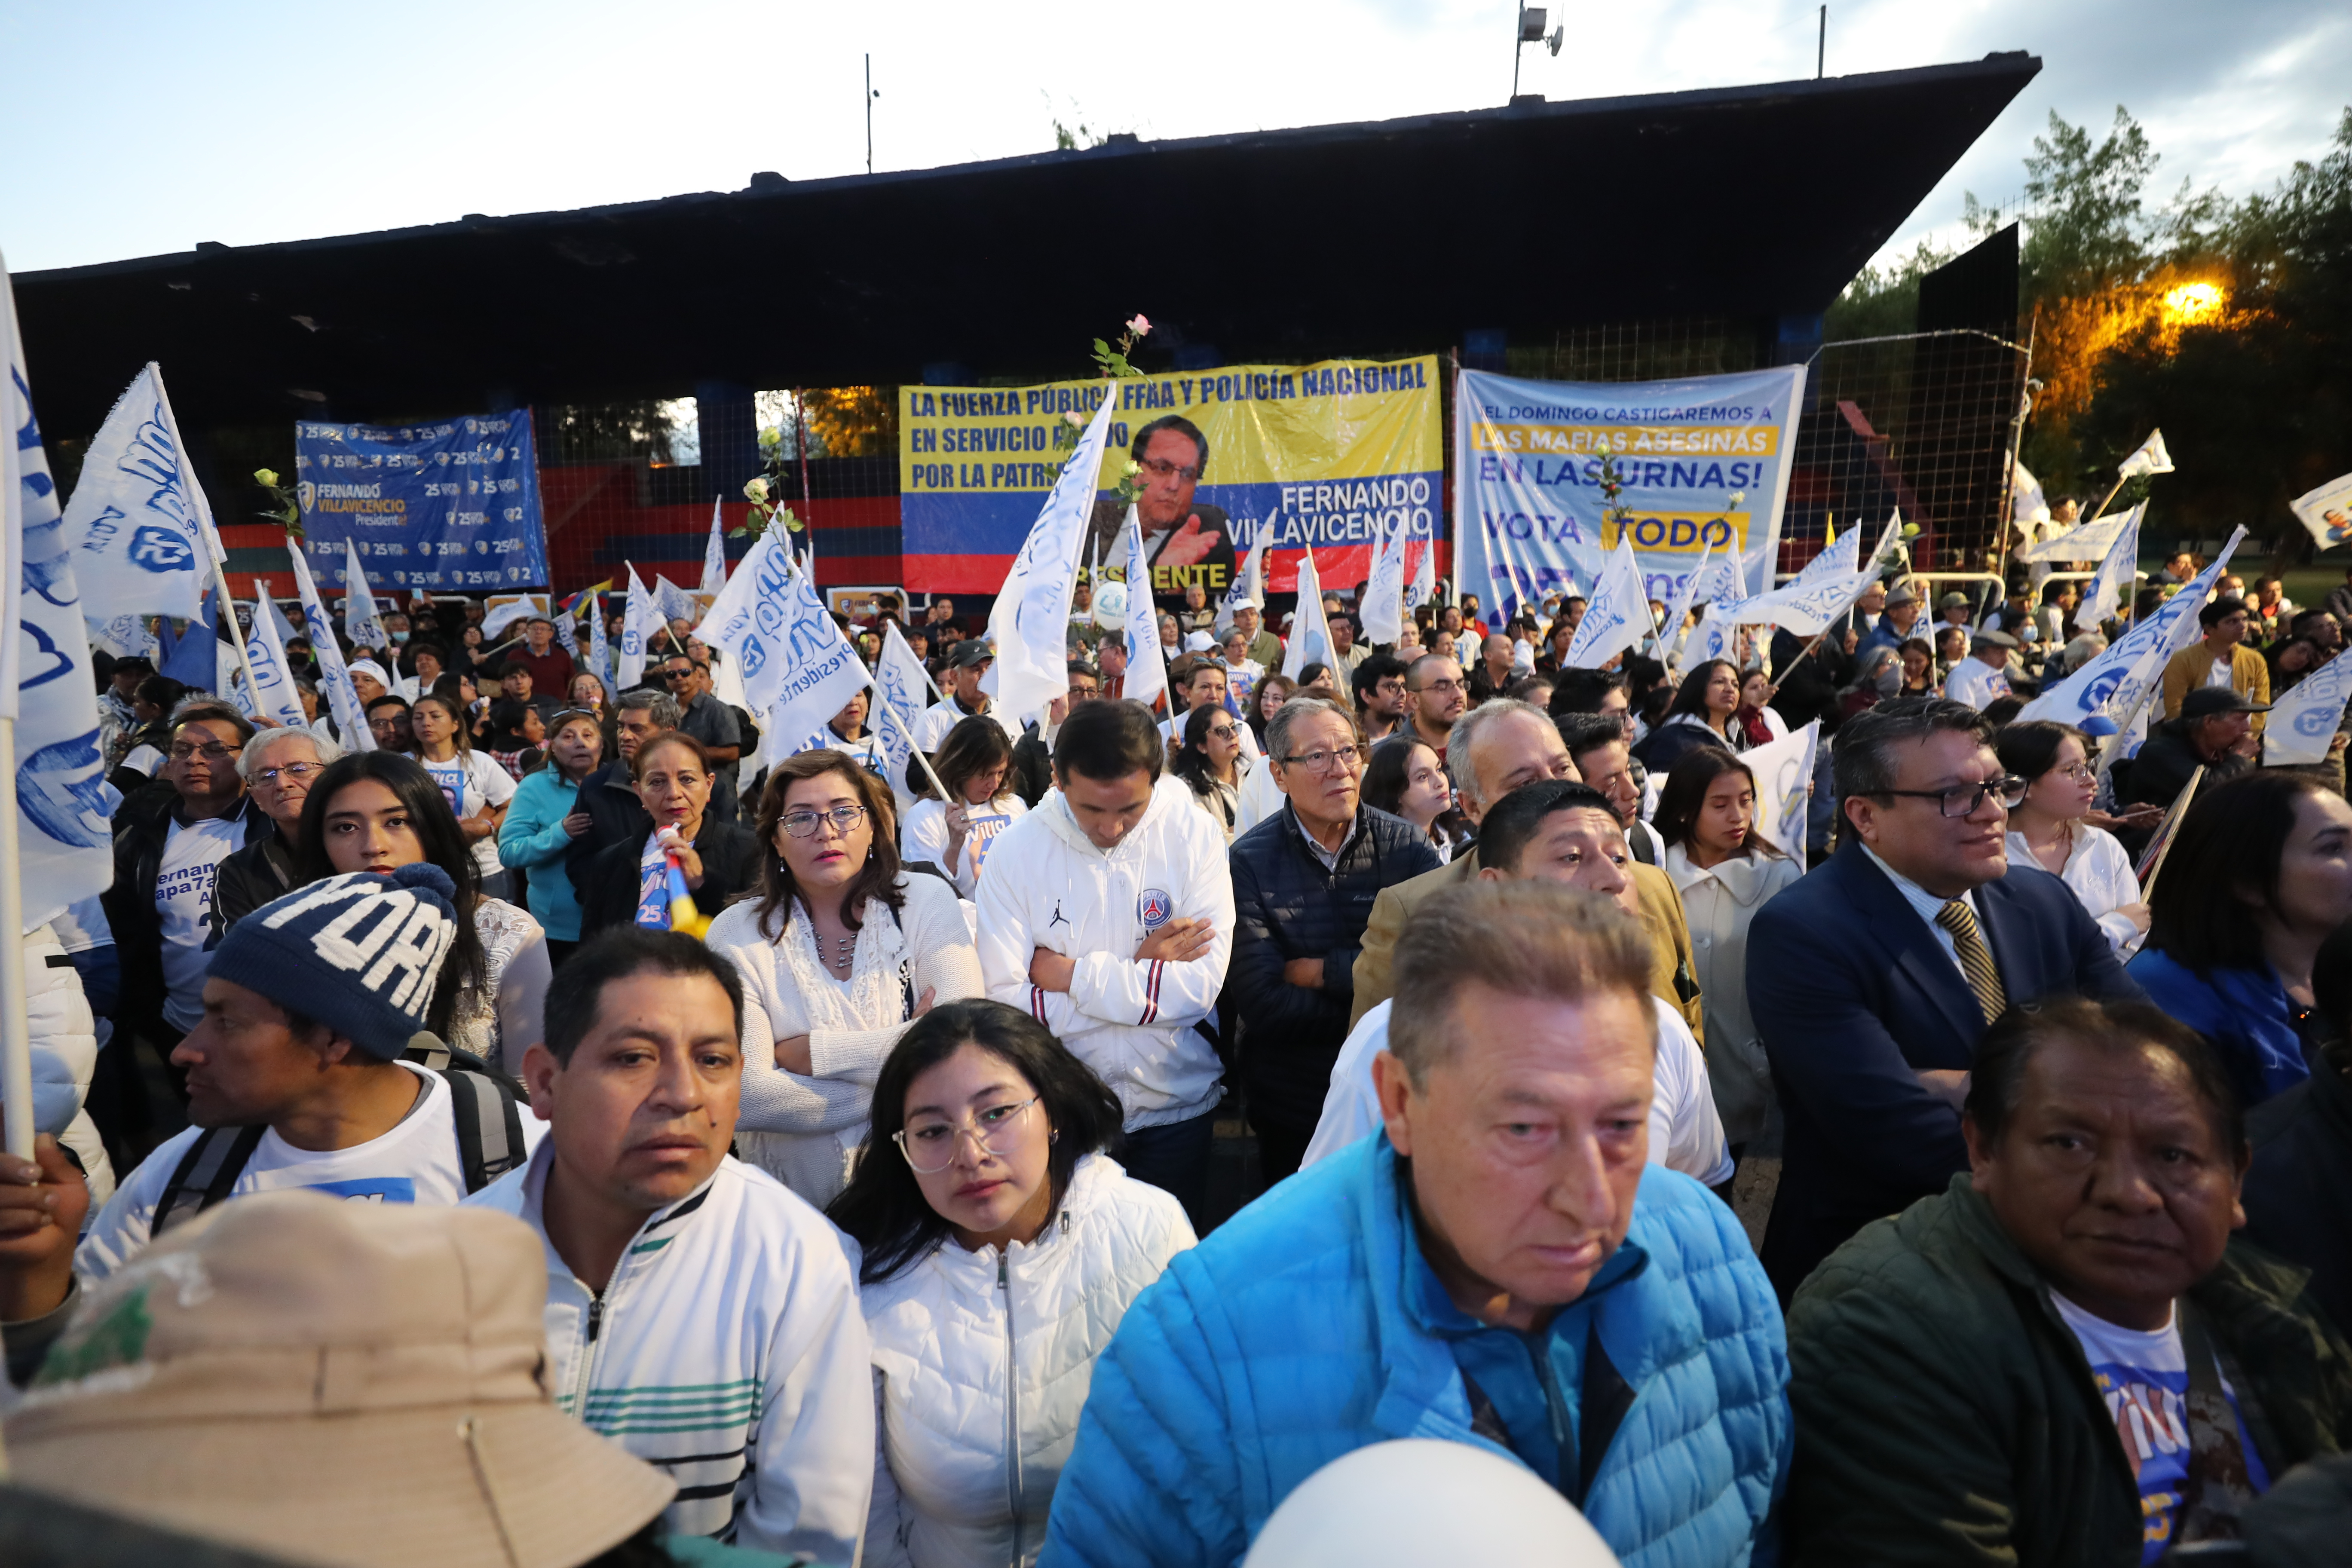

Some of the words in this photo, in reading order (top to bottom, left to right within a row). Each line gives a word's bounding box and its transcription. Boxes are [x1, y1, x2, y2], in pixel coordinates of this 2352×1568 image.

[911, 393, 936, 416] LA
[941, 391, 1021, 416] FUERZA
[1123, 381, 1175, 410] FFAA
[1180, 379, 1194, 405] Y
[1200, 369, 1296, 404] POLICÍA
[1302, 363, 1427, 398] NACIONAL
[1509, 406, 1598, 421] DOMINGO
[1604, 406, 1754, 421] CASTIGAREMOS
[1759, 406, 1772, 421] A
[911, 428, 937, 452] EN
[942, 426, 1046, 453] SERVICIO
[1480, 428, 1522, 449] LAS
[1530, 431, 1627, 451] MAFIAS
[1633, 432, 1767, 453] ASESINAS
[912, 464, 954, 488] POR
[961, 463, 986, 488] LA
[1480, 456, 1523, 483] EN
[1536, 459, 1603, 486] LAS
[1617, 461, 1762, 489] URNAS!
[317, 484, 381, 499] FERNANDO
[1282, 477, 1430, 514] FERNANDO
[318, 499, 406, 513] VILLAVICENCIO
[1482, 511, 1584, 545] VOTA
[1614, 518, 1732, 547] TODO
[317, 542, 332, 554] 25
[373, 542, 387, 556] 25
[492, 540, 510, 554] 25
[409, 571, 426, 584] 25
[466, 571, 483, 584] 25
[157, 863, 215, 885] ernan
[156, 876, 214, 900] apa7a
[638, 904, 662, 923] 25
